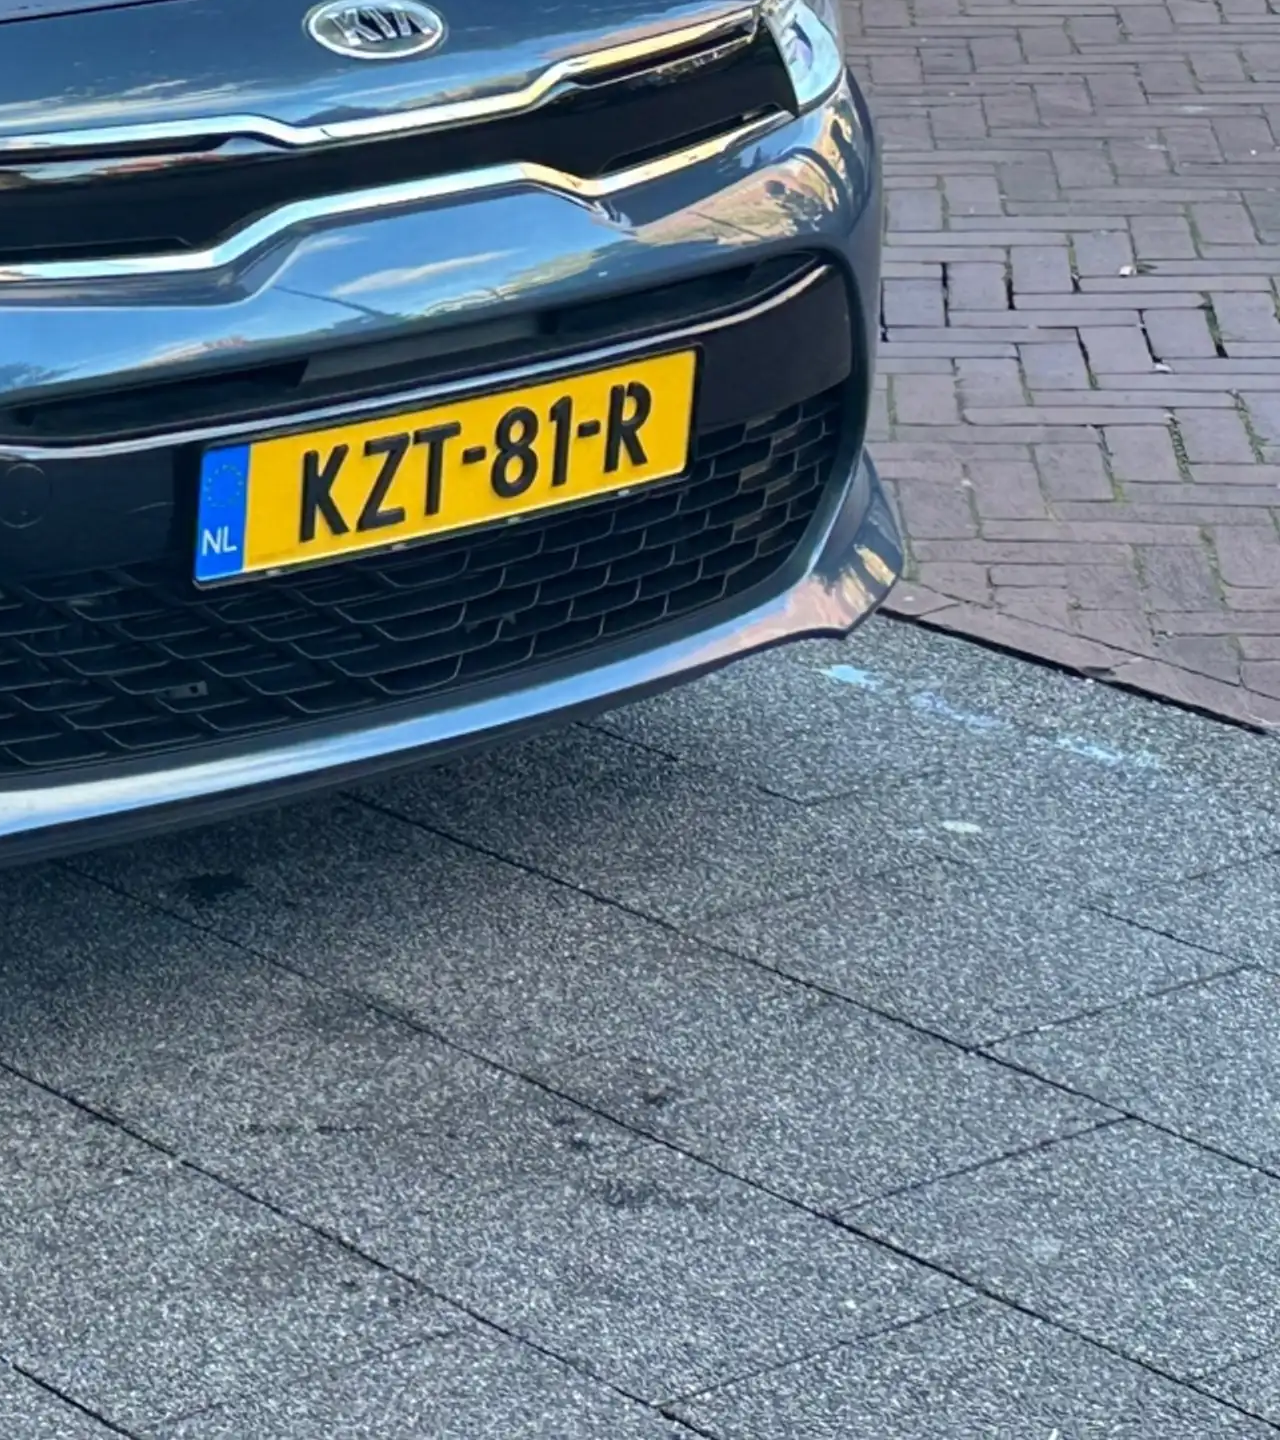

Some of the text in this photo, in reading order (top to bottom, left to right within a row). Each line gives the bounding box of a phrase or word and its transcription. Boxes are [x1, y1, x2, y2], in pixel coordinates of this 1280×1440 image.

[324, 7, 433, 46] KIA
[299, 381, 651, 543] KZT-81-R
[202, 526, 237, 557] NL
